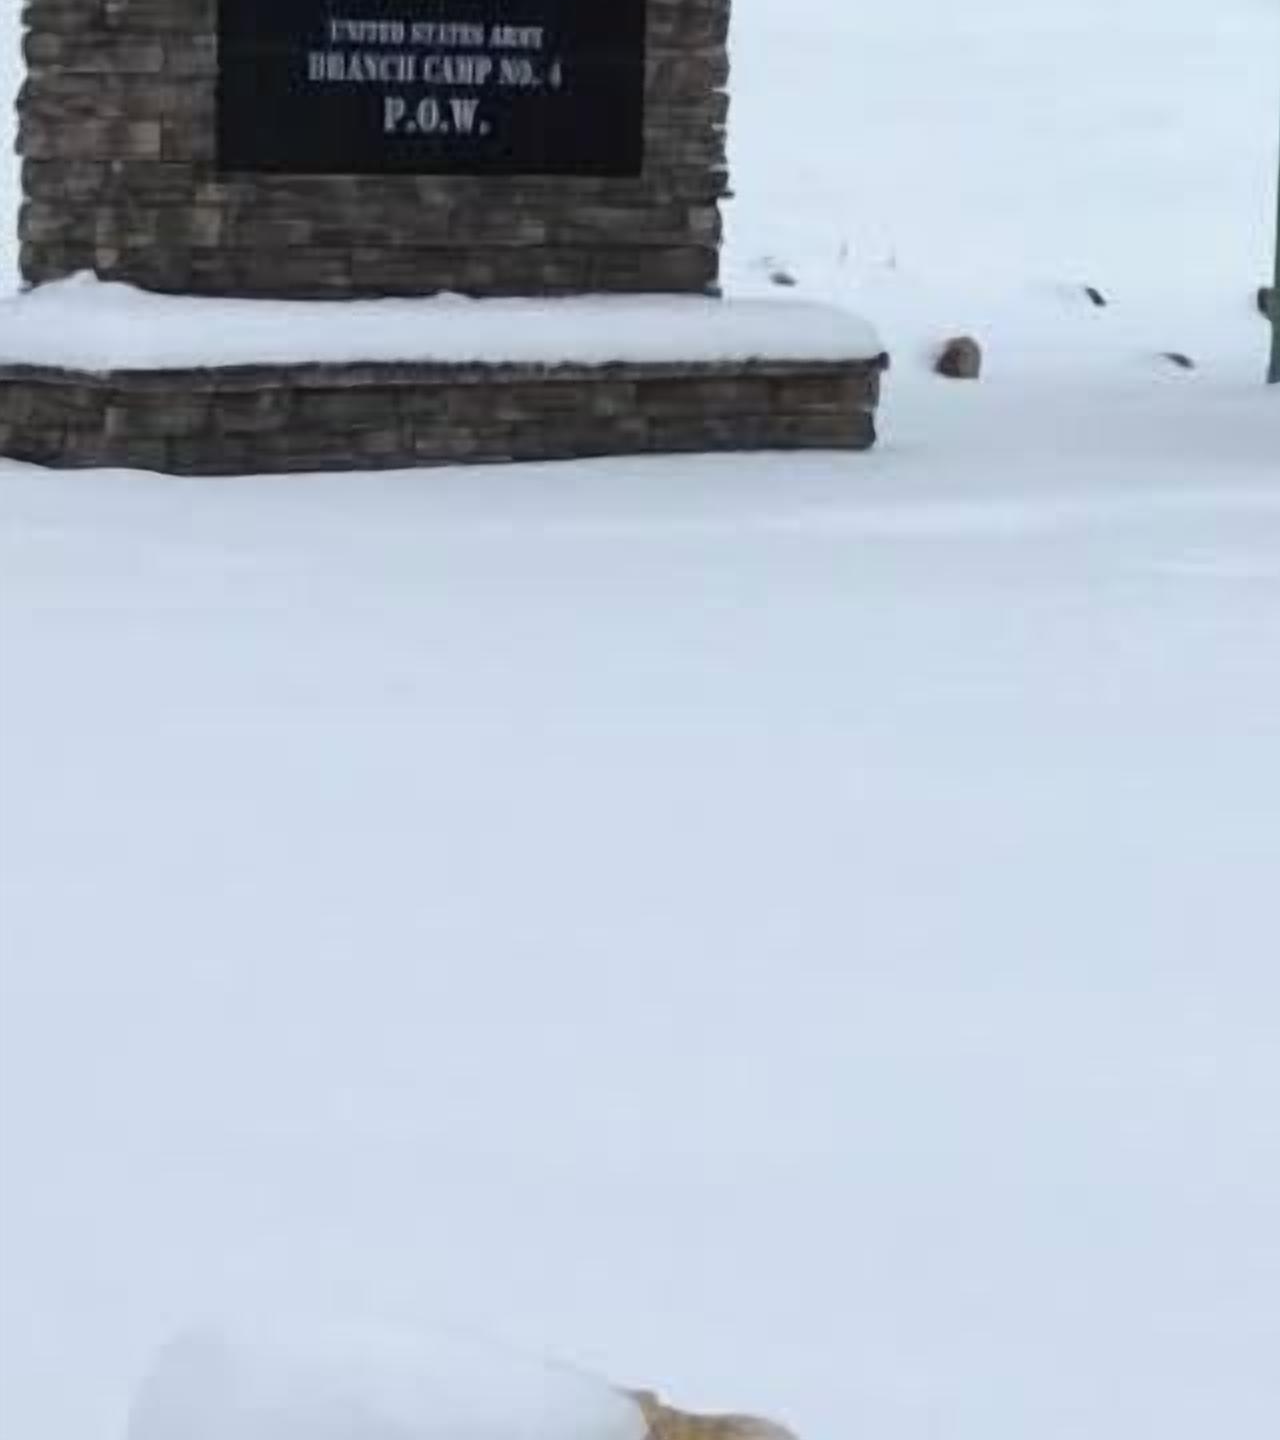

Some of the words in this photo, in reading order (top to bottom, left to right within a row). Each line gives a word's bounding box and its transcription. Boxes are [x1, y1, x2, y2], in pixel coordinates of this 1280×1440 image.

[331, 18, 405, 44] UNITED
[410, 21, 485, 47] STATES
[488, 24, 544, 50] ARMY
[308, 51, 416, 81] BRANCH
[422, 54, 493, 86] CAMP
[383, 95, 492, 137] P.O.W.
